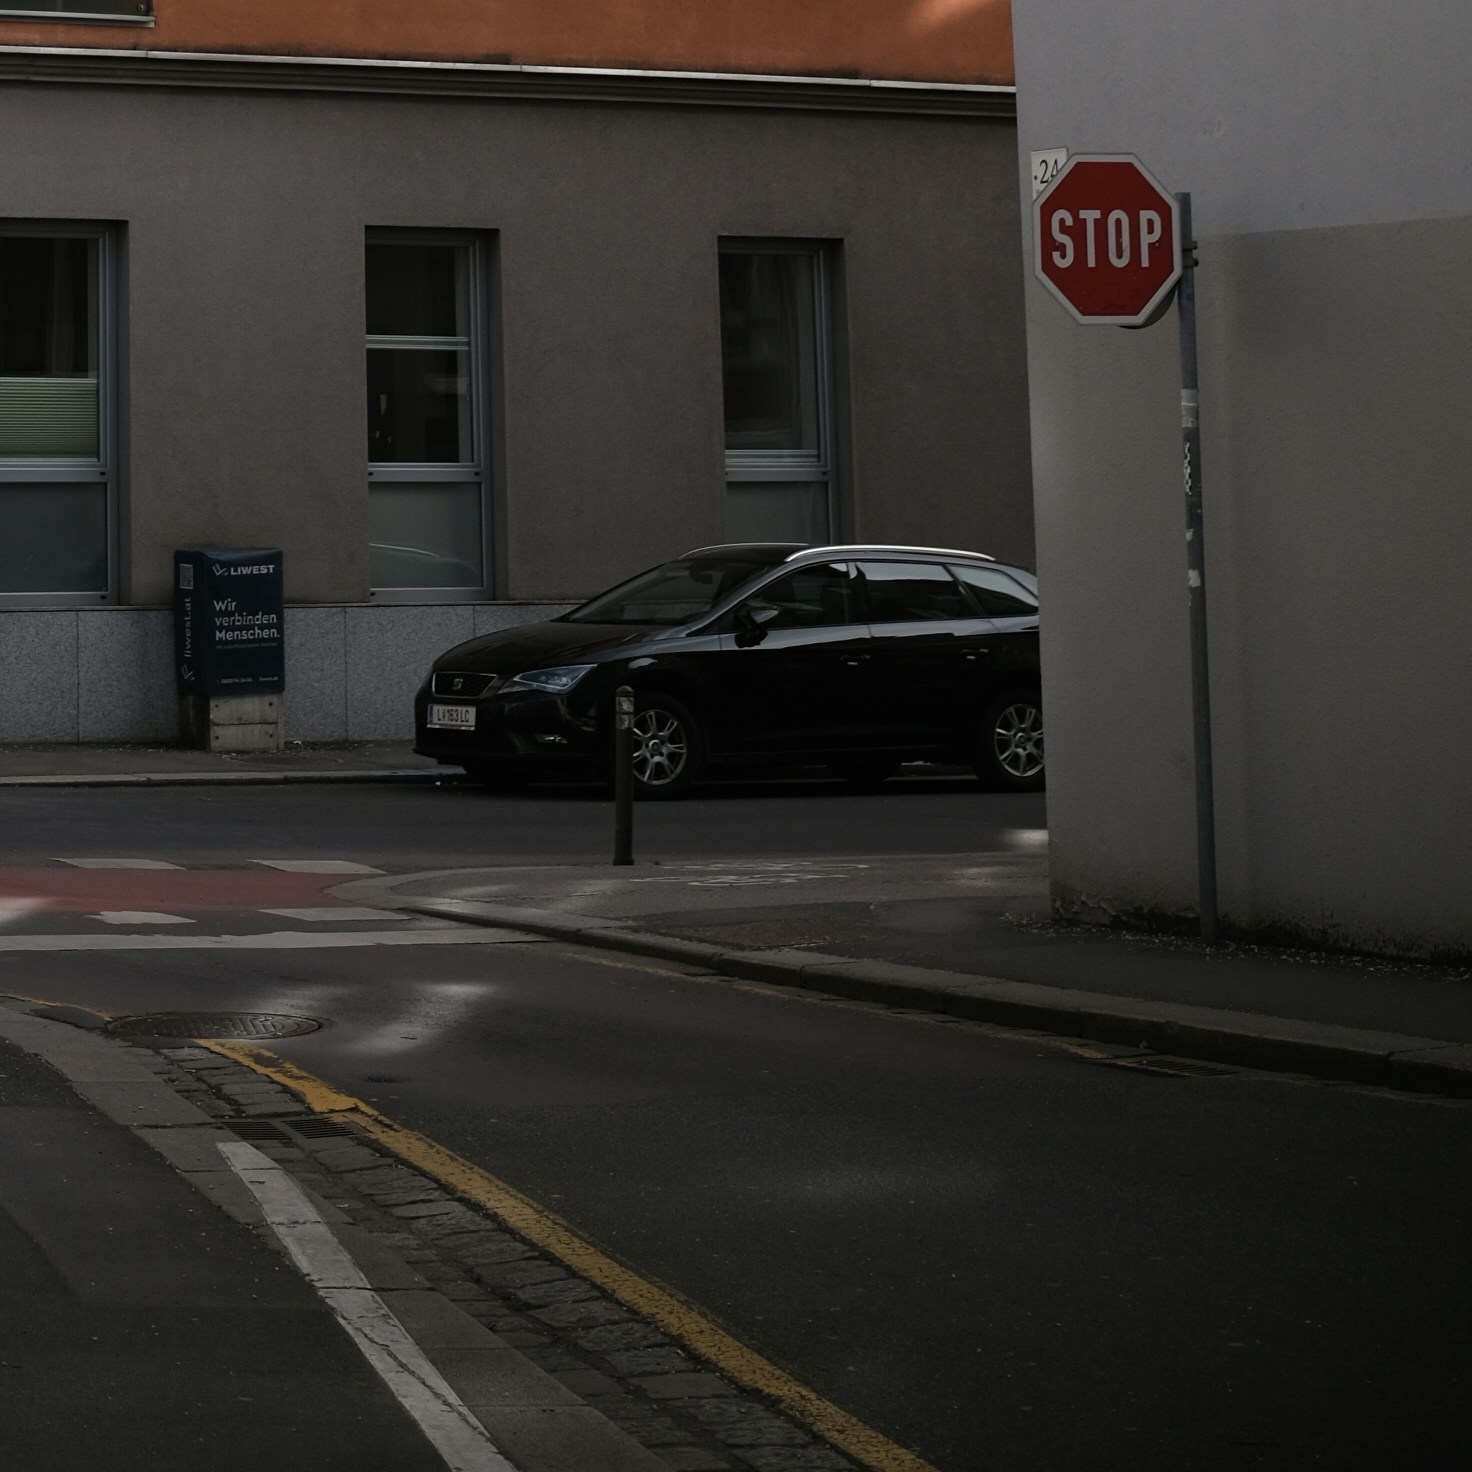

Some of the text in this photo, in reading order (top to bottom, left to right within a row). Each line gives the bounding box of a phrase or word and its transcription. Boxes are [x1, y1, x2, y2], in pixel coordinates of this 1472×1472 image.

[1051, 209, 1162, 268] STOP
[230, 564, 275, 575] LIWEST
[213, 597, 237, 612] Wir
[214, 611, 277, 626] verbinden
[215, 626, 281, 641] Menschen.
